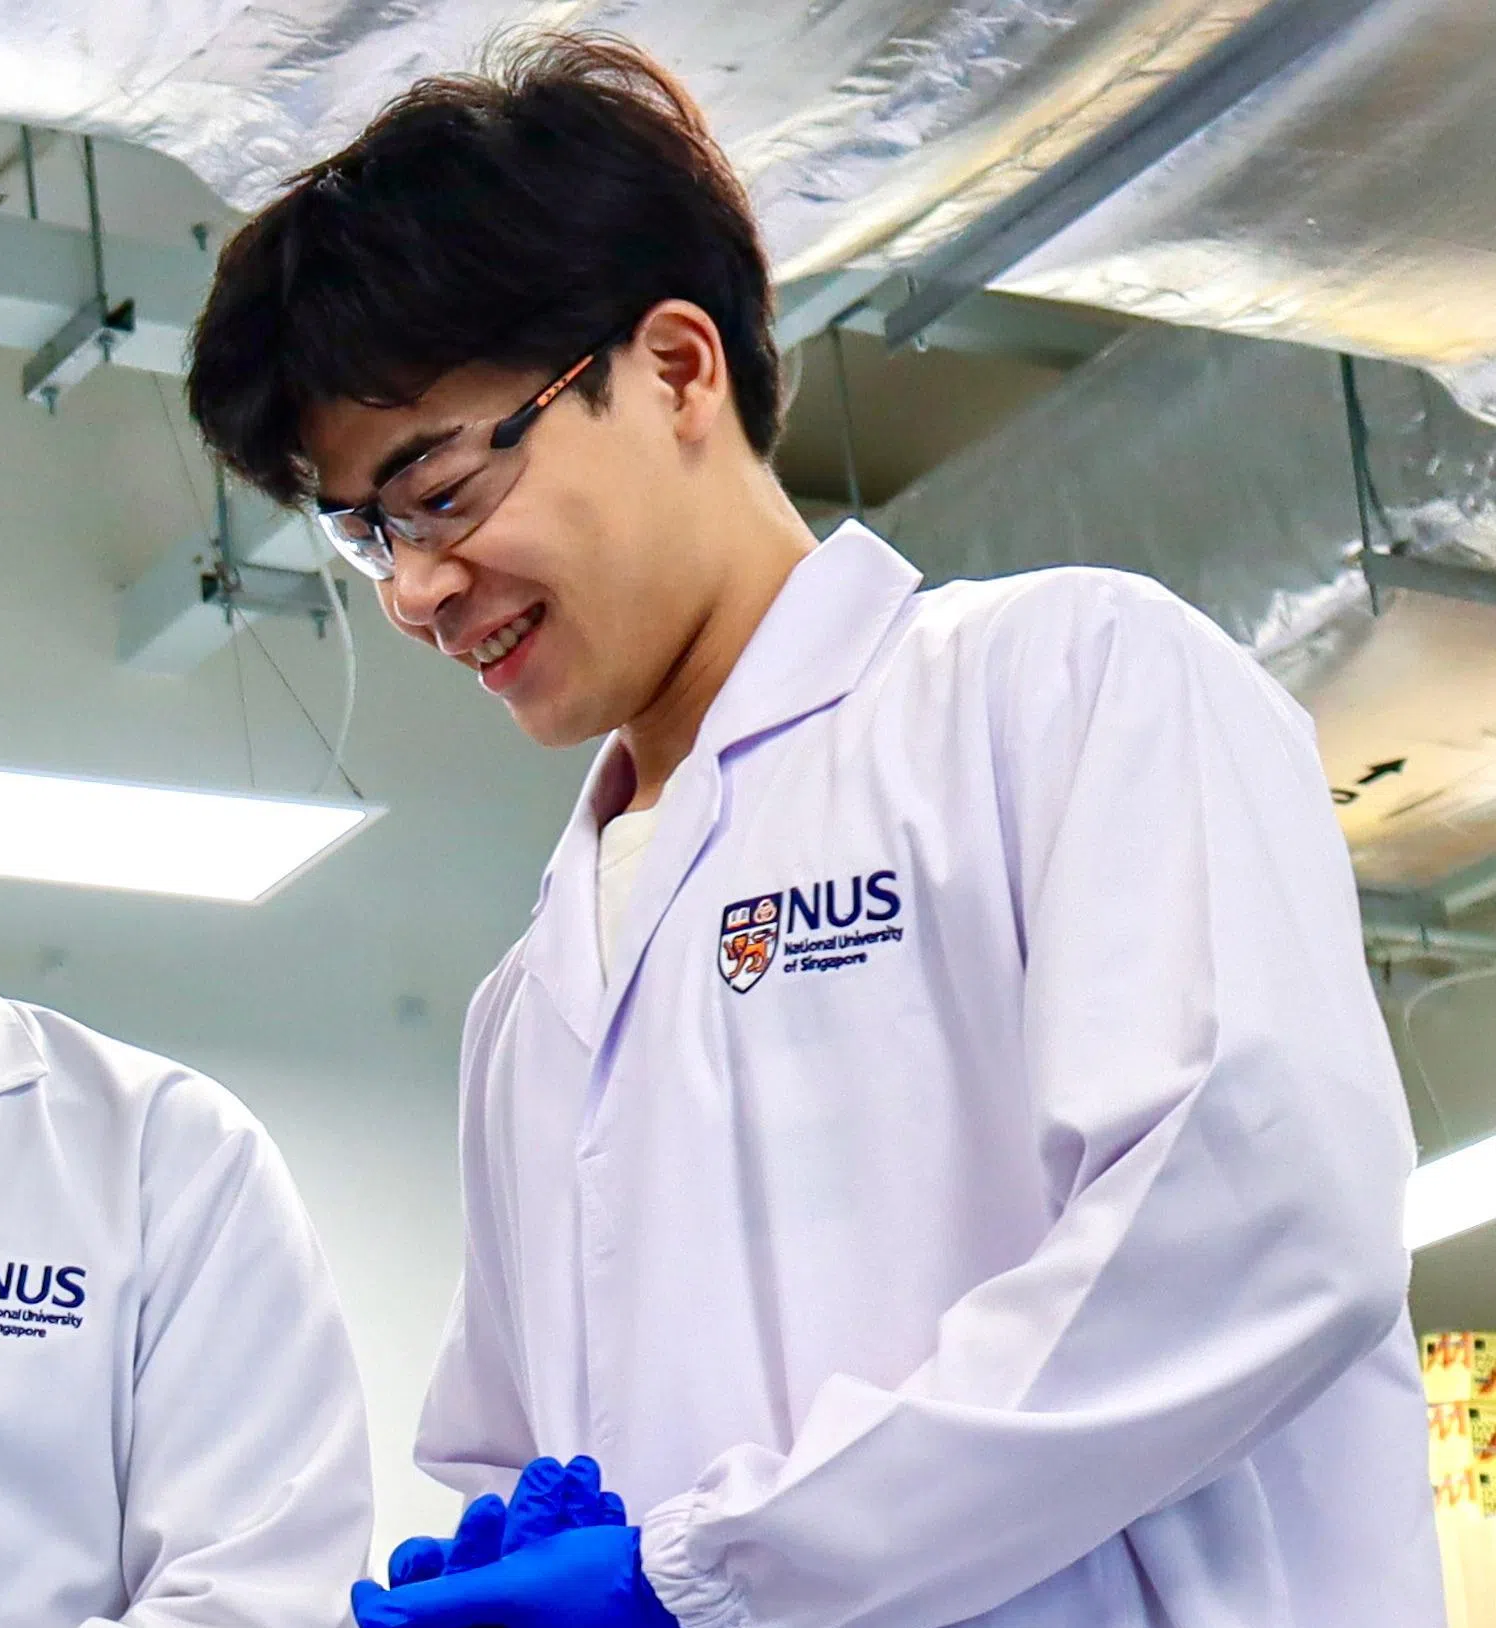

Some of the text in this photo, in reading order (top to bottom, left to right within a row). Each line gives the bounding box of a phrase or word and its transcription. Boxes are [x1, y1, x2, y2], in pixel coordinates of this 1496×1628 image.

[787, 870, 901, 934] NUS
[784, 926, 903, 955] National University
[783, 953, 867, 973] of Singapore
[23, 1310, 83, 1328] University
